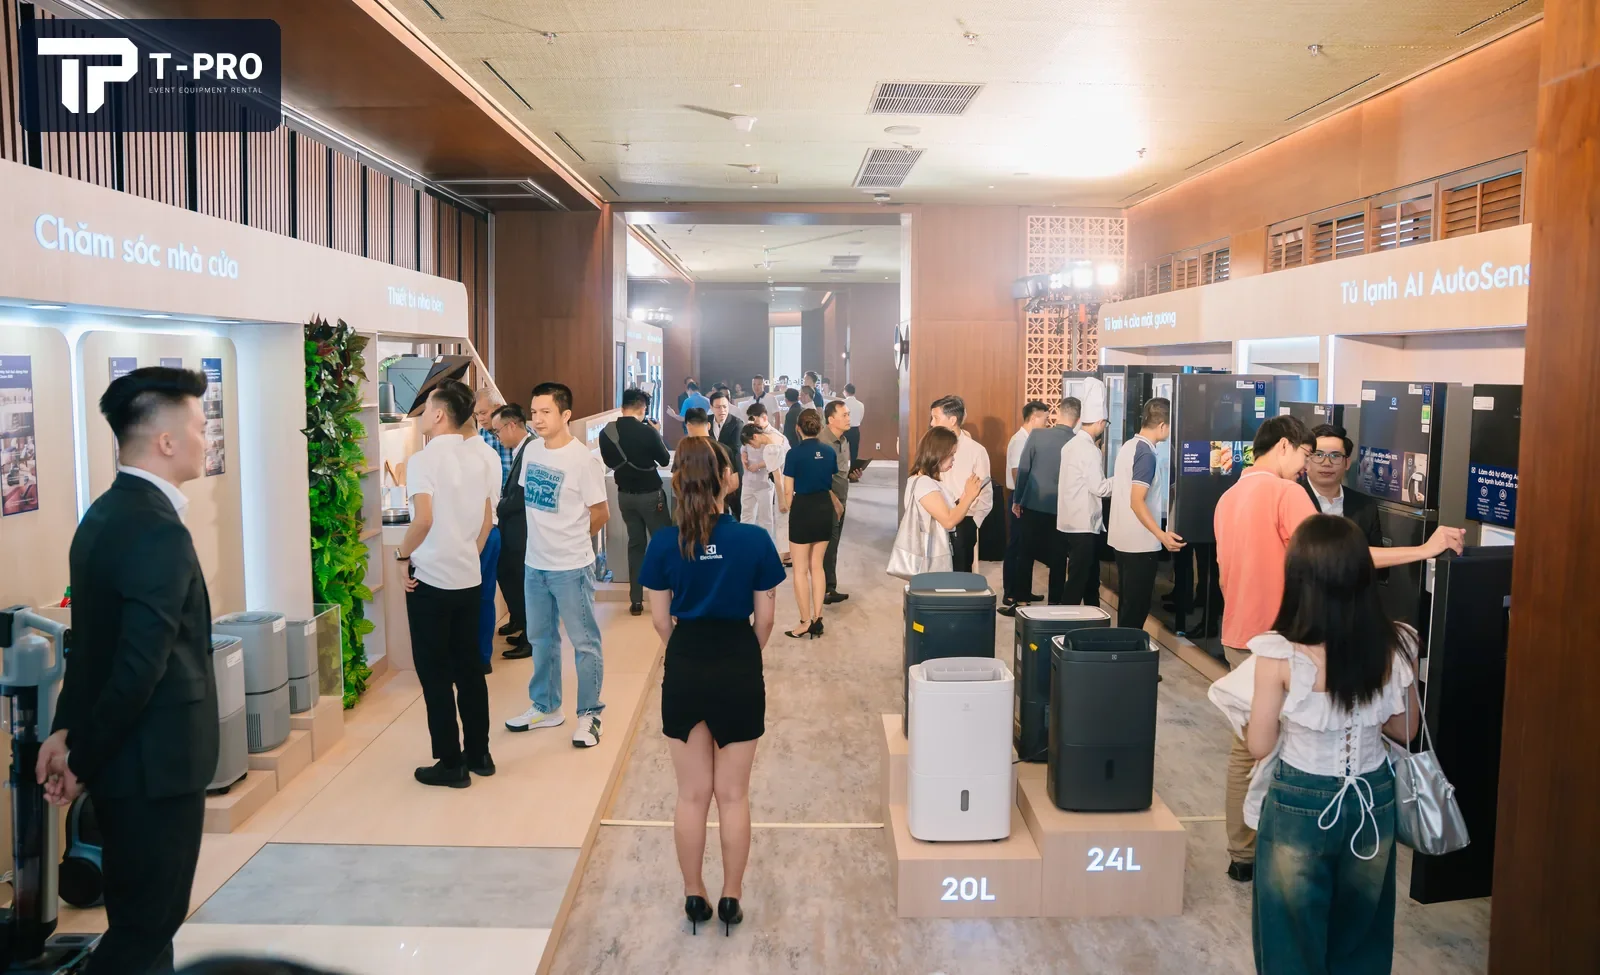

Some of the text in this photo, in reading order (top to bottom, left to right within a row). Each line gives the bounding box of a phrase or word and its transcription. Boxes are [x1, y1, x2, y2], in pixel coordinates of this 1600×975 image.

[34, 213, 239, 280] Chăm sóc nhà cửa
[1340, 279, 1358, 304] Tủ
[1363, 275, 1398, 306] lạnh
[1404, 271, 1424, 298] AI
[1124, 315, 1129, 328] 4
[1086, 847, 1141, 872] 24L
[940, 876, 995, 901] 20L
